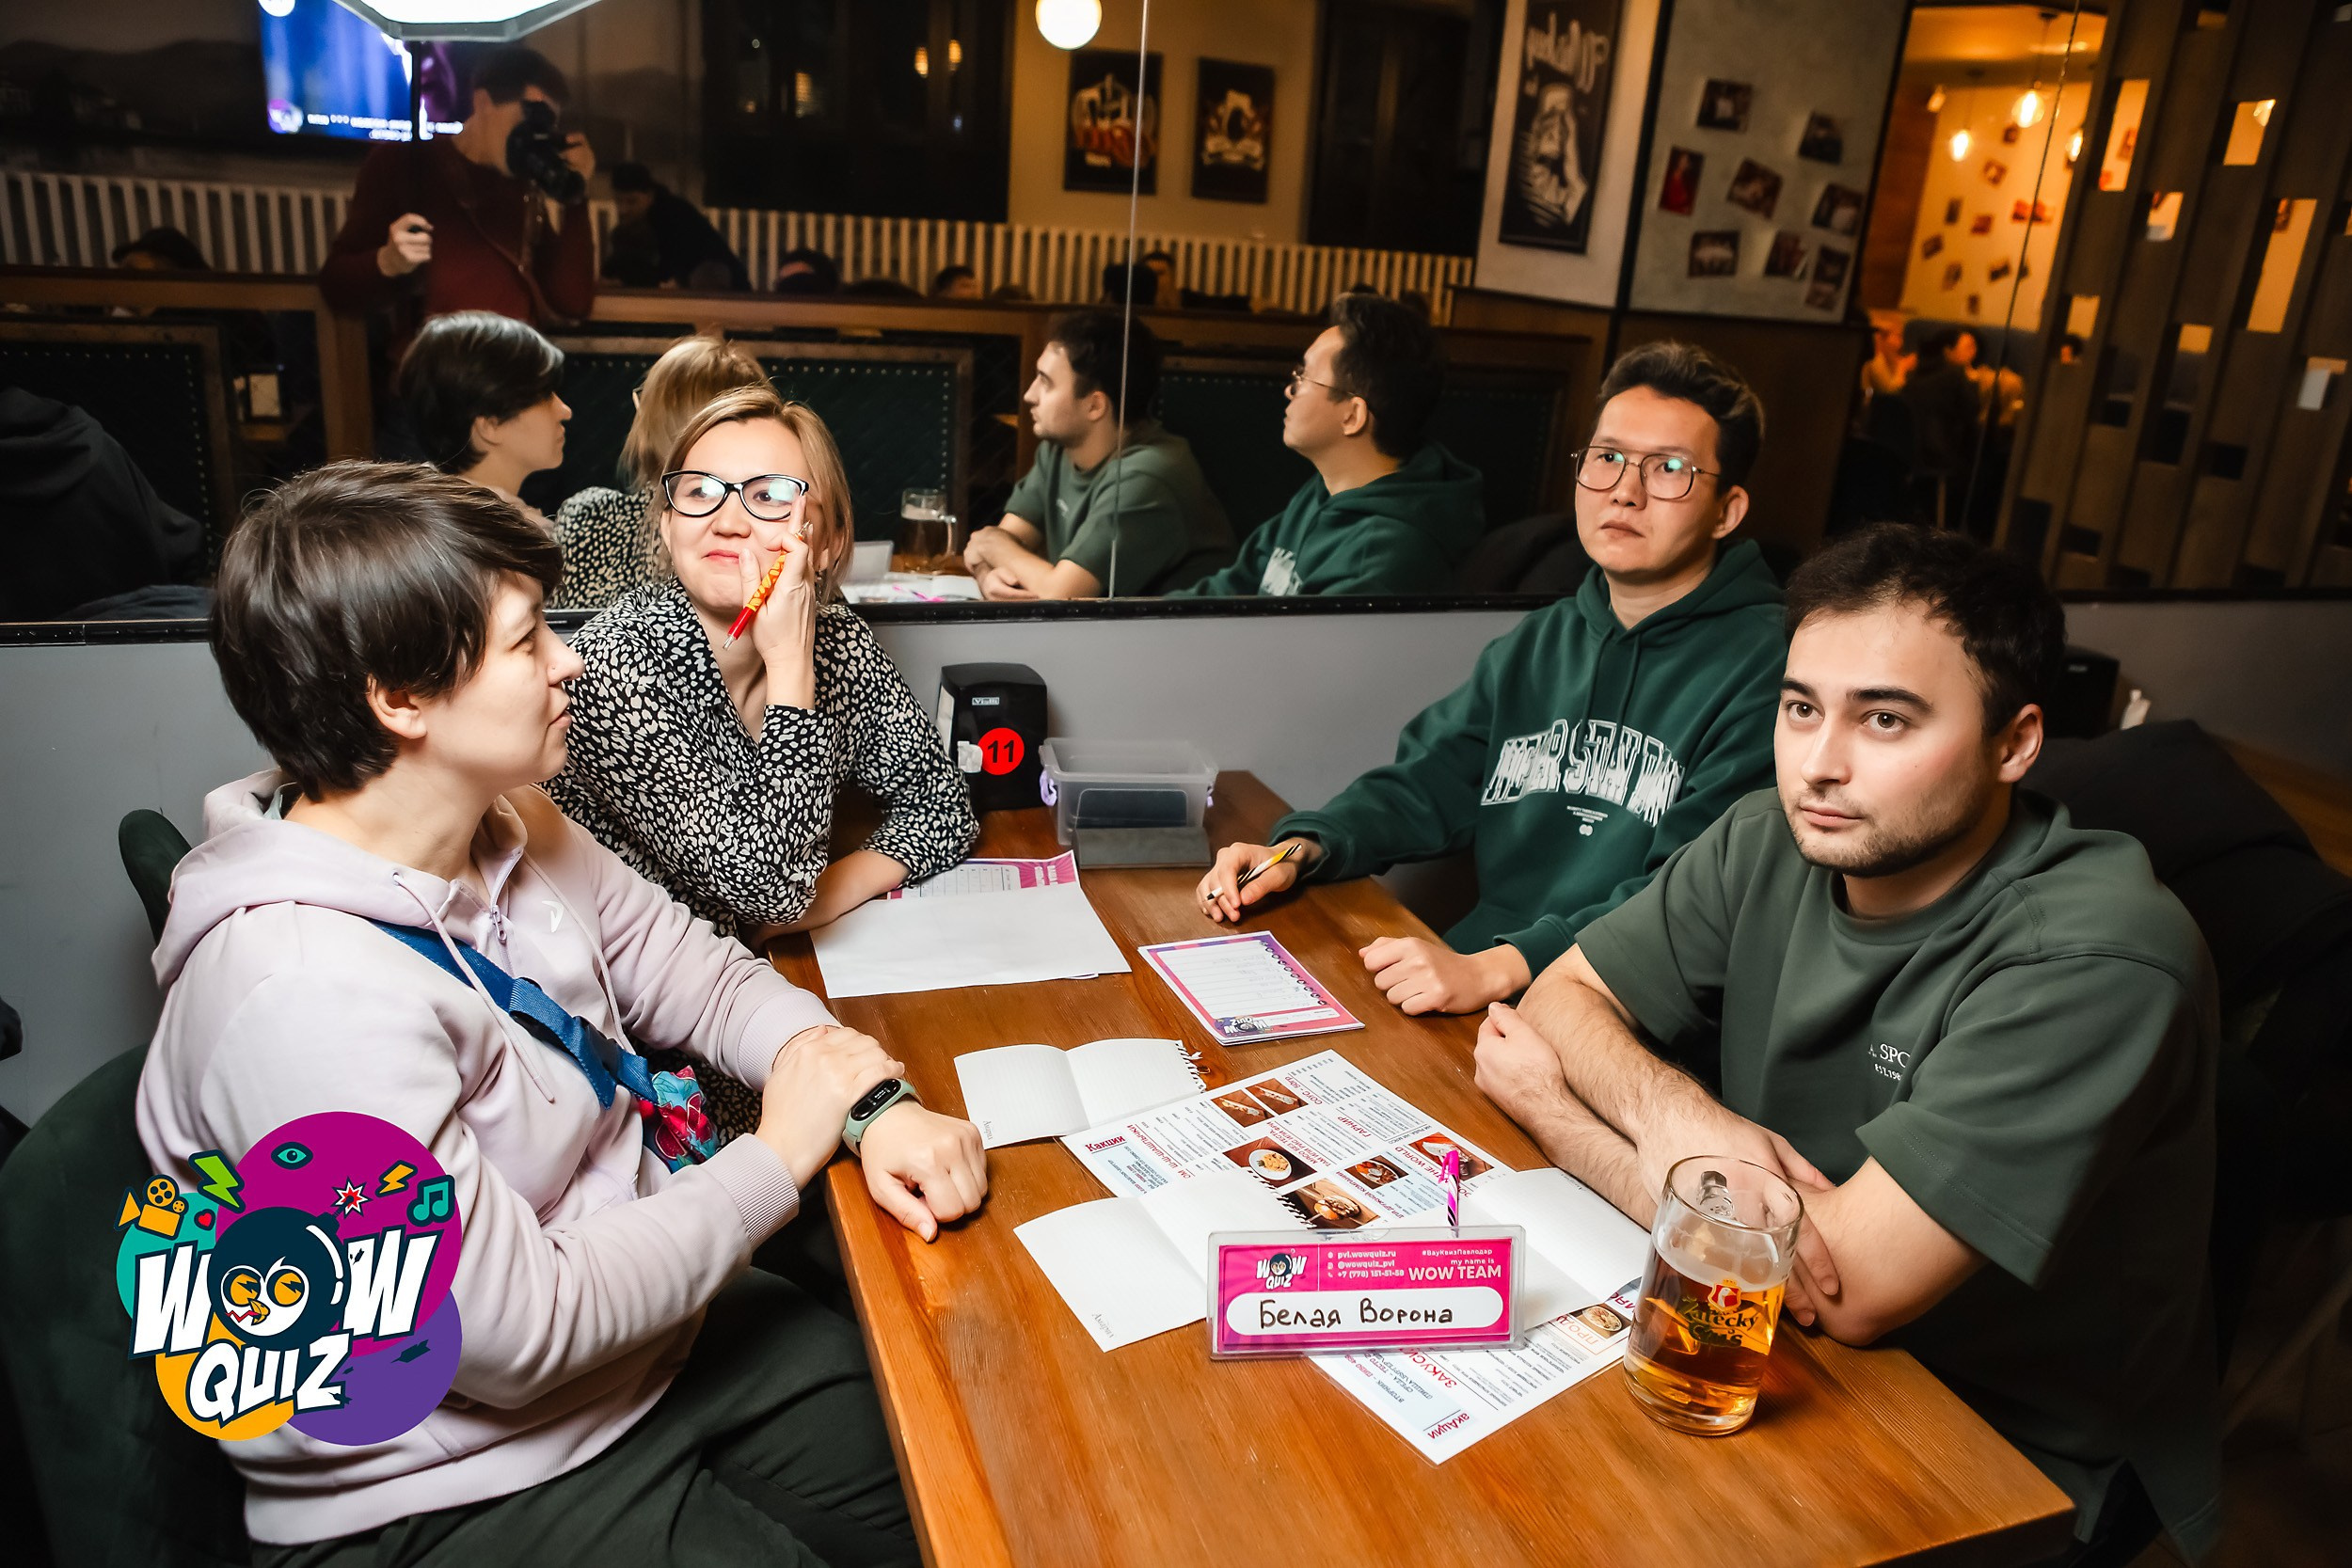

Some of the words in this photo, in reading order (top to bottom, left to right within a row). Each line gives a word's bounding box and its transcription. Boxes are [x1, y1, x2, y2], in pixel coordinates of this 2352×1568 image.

[988, 740, 1014, 763] 11
[1299, 1090, 1324, 1104] СОУС
[1336, 1116, 1372, 1137] ГАРНИР
[1085, 1135, 1126, 1152] Какции
[1290, 1139, 1306, 1148] РИС
[1296, 1150, 1318, 1164] МЯСО
[1315, 1157, 1331, 1166] ТАМ
[1393, 1146, 1427, 1166] WORLD
[1338, 1250, 1396, 1259] pvl.wowquiz.ru
[1422, 1249, 1492, 1258] #ВауКвизПавлодар
[1257, 1253, 1307, 1280] WOW
[1338, 1260, 1394, 1269] @wowquiz_pvl
[1408, 1267, 1454, 1280] WOW
[1457, 1265, 1502, 1279] TEAM
[1265, 1275, 1292, 1291] QUIZ
[1260, 1299, 1341, 1329] Белая
[1360, 1297, 1454, 1324] Ворона
[1355, 1362, 1374, 1377] ПИВО
[1368, 1357, 1390, 1373] ТЕСТО
[1375, 1379, 1405, 1402] ВТОРНИК
[1391, 1375, 1414, 1393] СРЕДА
[1425, 1410, 1470, 1440] акАции
